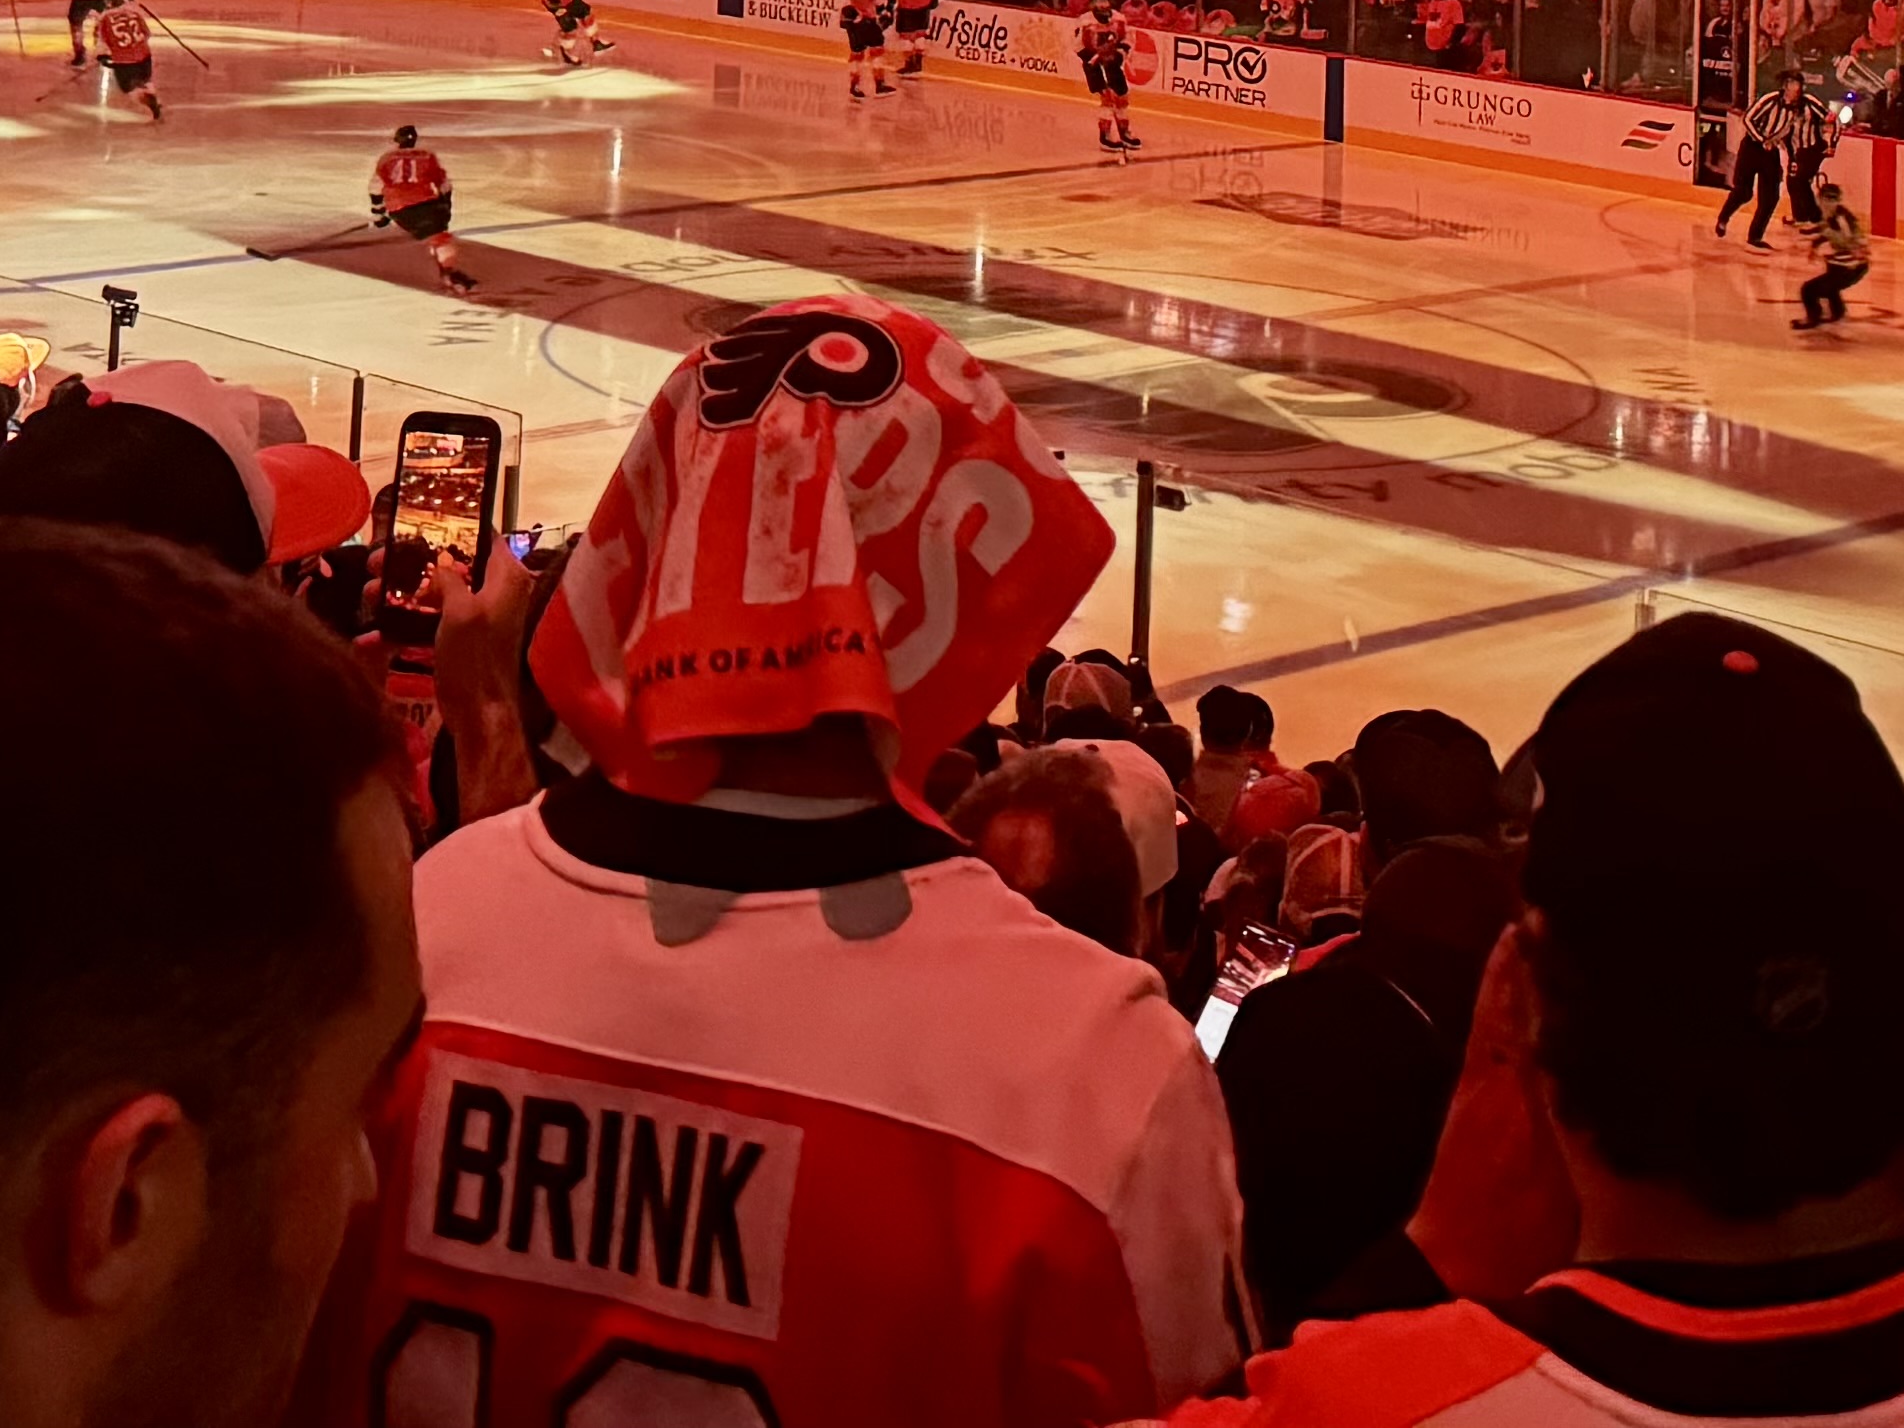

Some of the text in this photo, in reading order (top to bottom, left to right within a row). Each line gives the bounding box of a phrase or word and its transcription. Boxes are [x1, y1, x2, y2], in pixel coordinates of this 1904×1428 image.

[747, 0, 833, 28] & BUCKELEW
[925, 9, 1009, 52] urfside
[955, 46, 1059, 74] ICED TEA VODKA
[1172, 36, 1268, 84] PRO
[1171, 76, 1267, 108] PARTNER
[1433, 84, 1533, 119] GRUNGO
[1468, 111, 1496, 127] LAW
[708, 648, 752, 674] OF
[433, 1079, 766, 1309] BRINK
